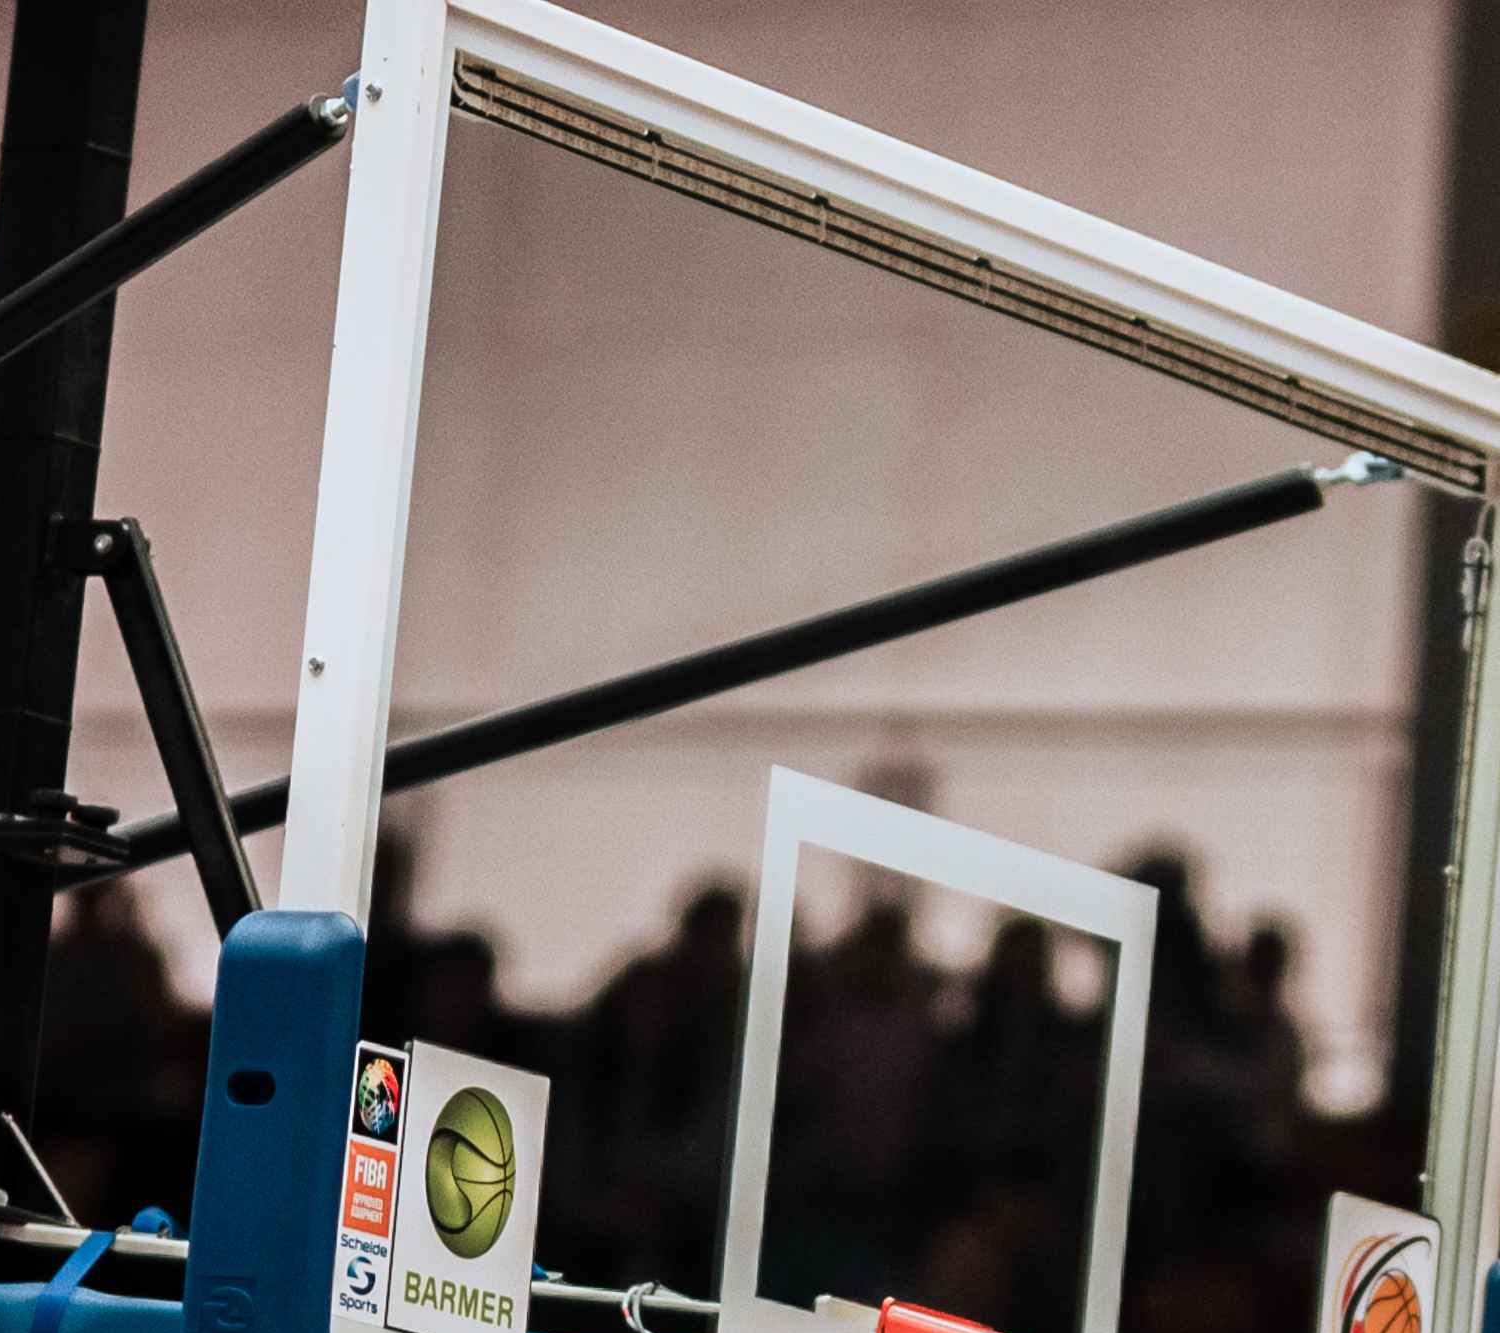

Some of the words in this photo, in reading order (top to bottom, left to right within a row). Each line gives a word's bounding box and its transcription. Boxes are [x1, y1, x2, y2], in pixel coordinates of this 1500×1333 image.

[354, 1154, 388, 1190] FIBA
[340, 1233, 388, 1258] Schelde
[339, 1292, 378, 1314] Sports
[404, 1270, 514, 1329] BARMER
